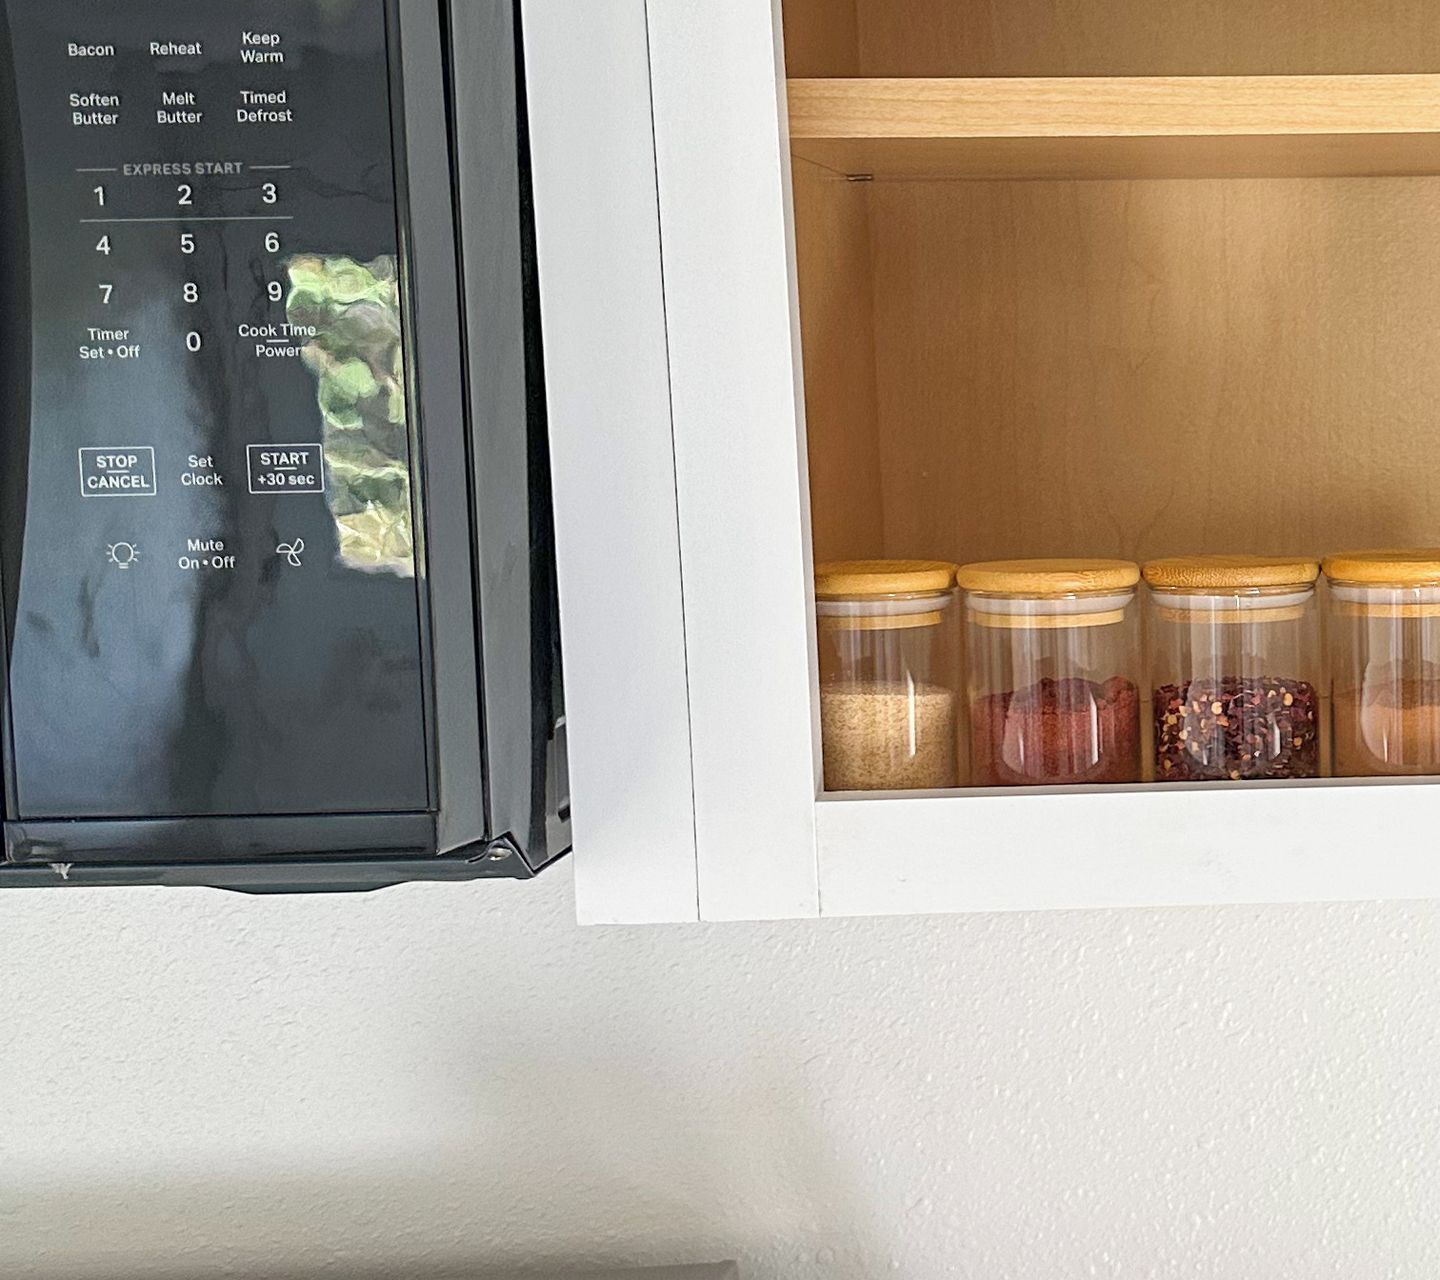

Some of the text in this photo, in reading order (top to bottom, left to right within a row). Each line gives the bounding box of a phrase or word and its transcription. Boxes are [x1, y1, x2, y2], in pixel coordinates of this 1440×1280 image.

[242, 31, 280, 46] Keep
[68, 43, 114, 57] Bacon
[150, 42, 202, 55] Reheat
[240, 50, 284, 63] Warm
[69, 93, 119, 107] Soften
[162, 92, 195, 105] Melt
[240, 90, 287, 104] Timed
[72, 112, 119, 125] Butter
[157, 111, 202, 123] Butter
[237, 109, 293, 122] Defrost
[123, 162, 243, 176] EXPRESS START
[94, 187, 105, 206] 1
[178, 185, 192, 205] 2
[263, 183, 277, 203] 3
[96, 236, 111, 255] 4
[181, 234, 194, 254] 5
[265, 233, 280, 253] 6
[100, 285, 113, 304] 7
[183, 284, 198, 303] 8
[268, 282, 283, 302] 9
[87, 328, 129, 341] Timer
[238, 323, 316, 337] Cook Time
[186, 332, 201, 352] 0
[79, 344, 140, 359] Set Off
[256, 344, 303, 357] Power
[96, 455, 137, 469] STOP
[188, 455, 214, 469] Set
[260, 452, 309, 466] START
[87, 475, 150, 489] CANCEL
[181, 472, 223, 486] Clock
[257, 472, 315, 486] +30 sec
[187, 539, 224, 552] Mute
[178, 555, 235, 569] On Off
